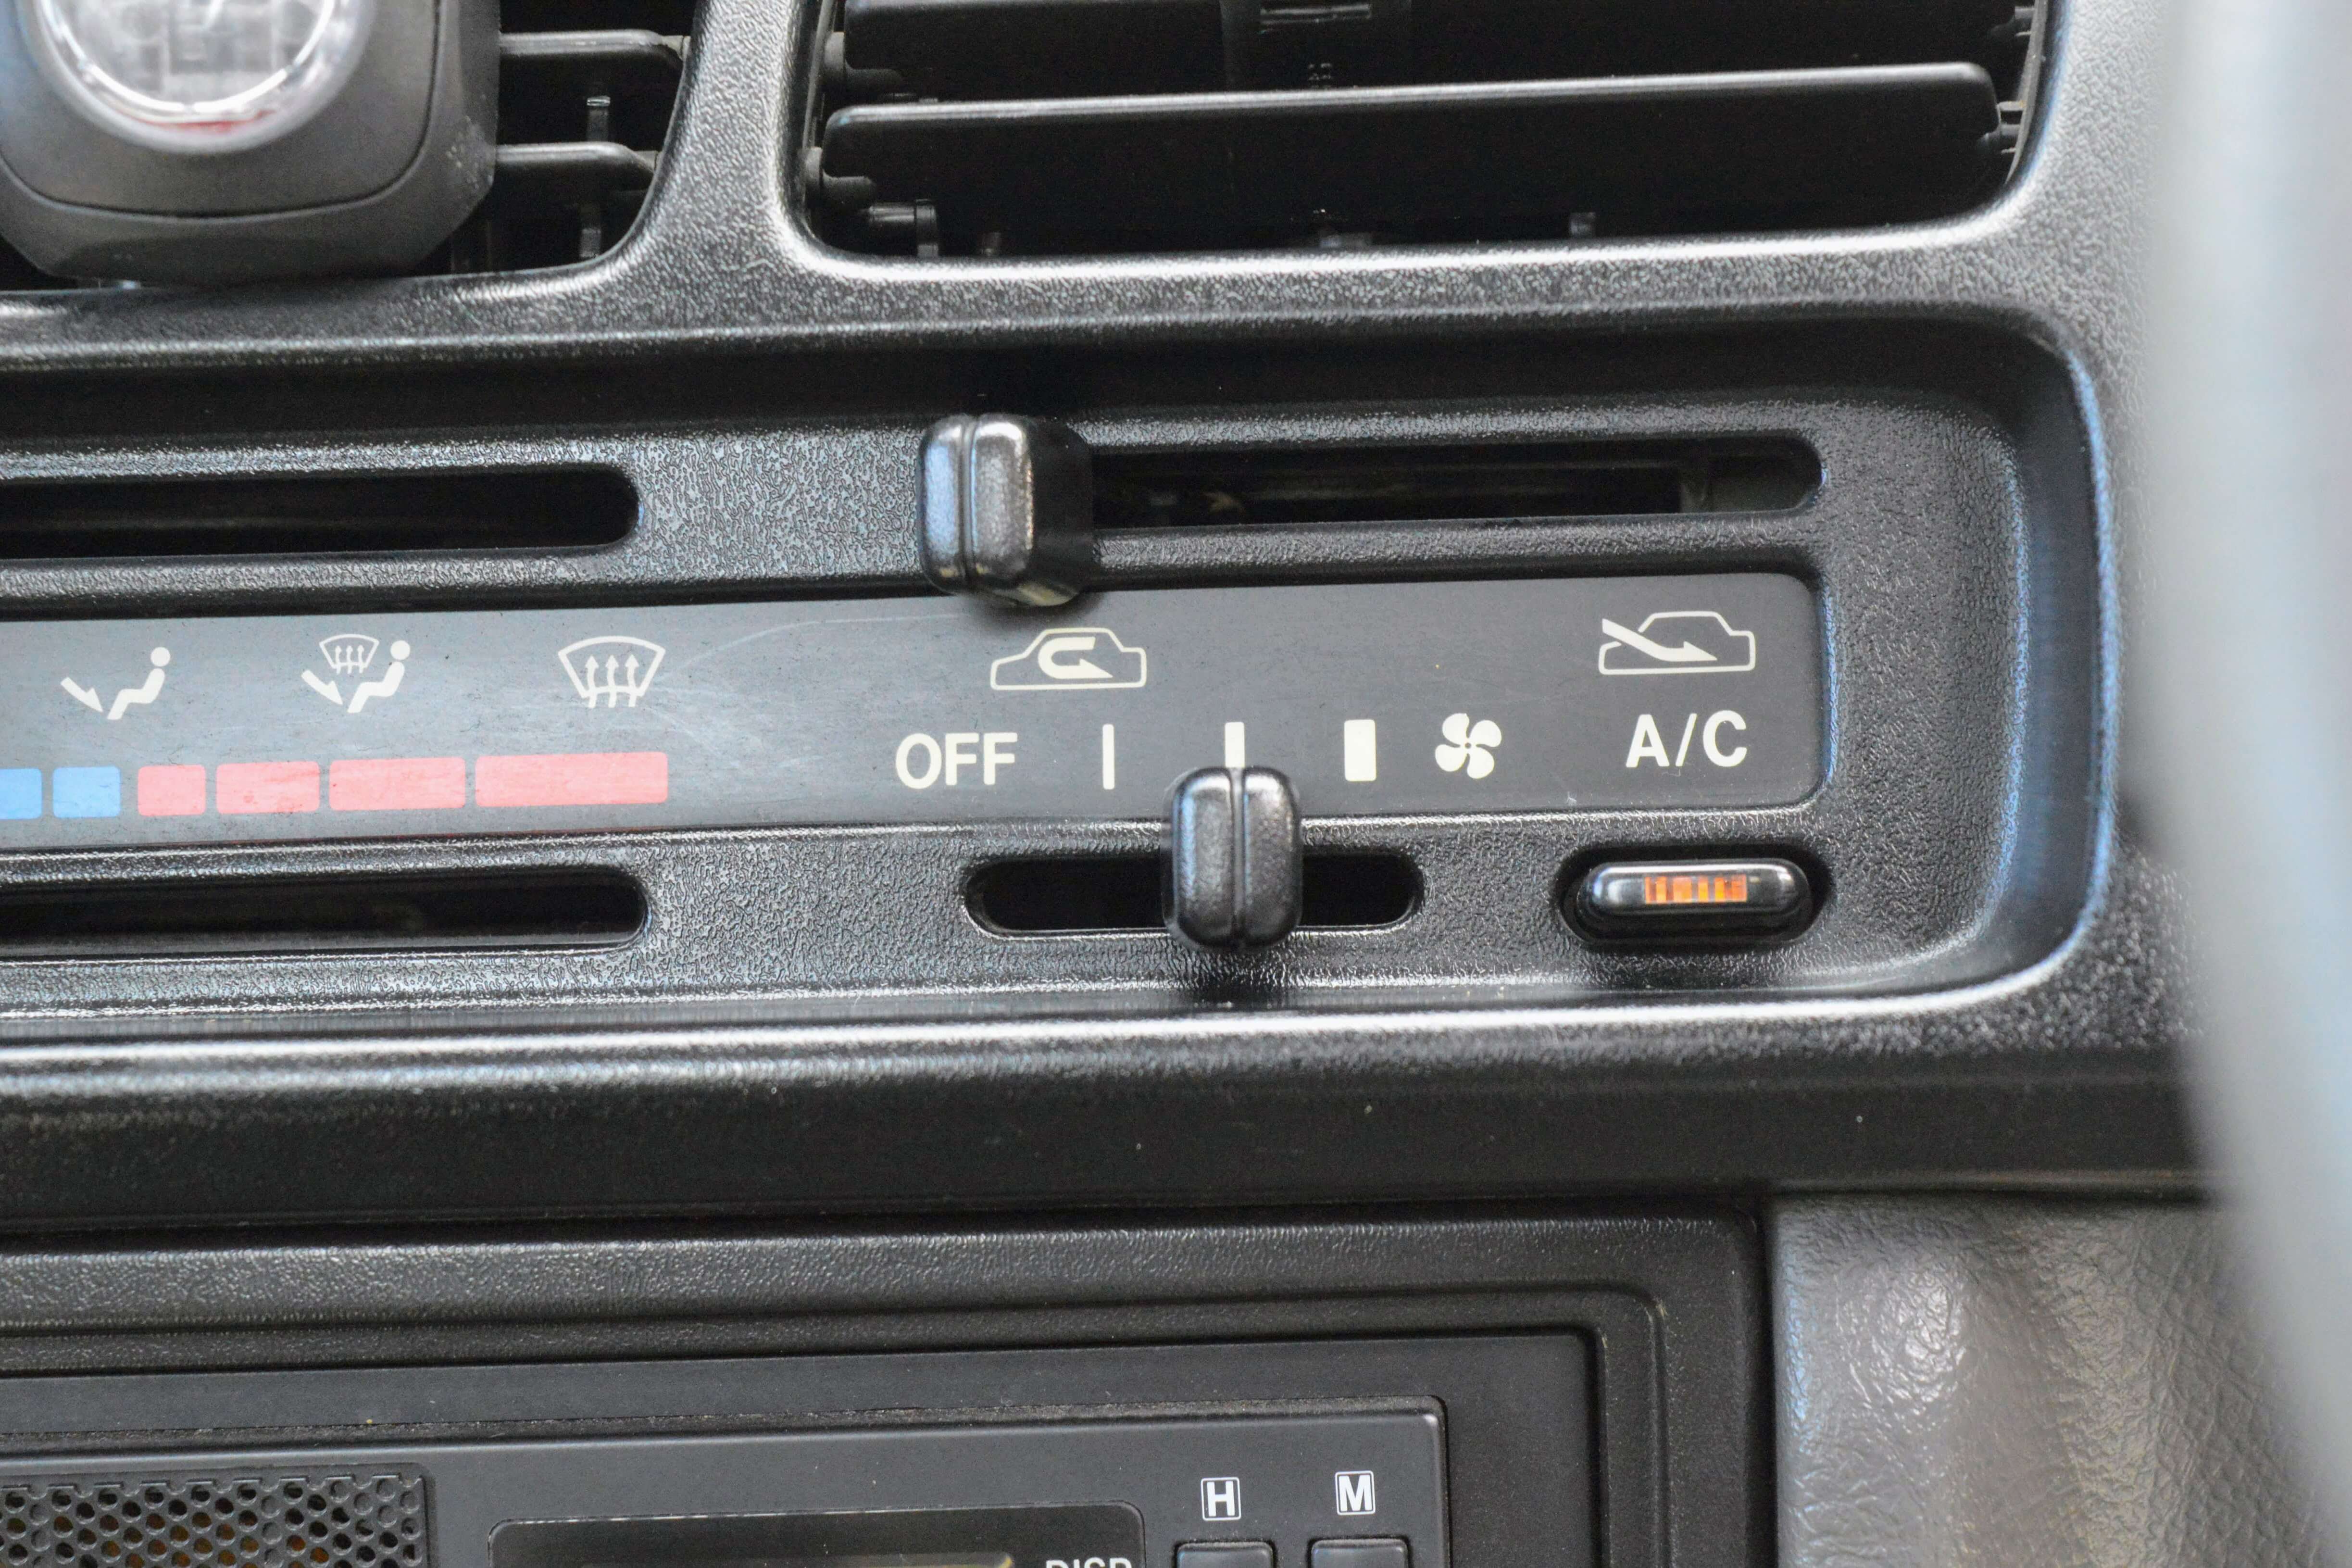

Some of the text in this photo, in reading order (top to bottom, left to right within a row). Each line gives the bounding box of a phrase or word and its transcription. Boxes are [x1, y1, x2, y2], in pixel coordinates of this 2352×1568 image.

[895, 732, 1018, 789] OFF
[1626, 710, 1748, 768] A/C
[1206, 1480, 1235, 1517] H
[1338, 1474, 1373, 1512] M
